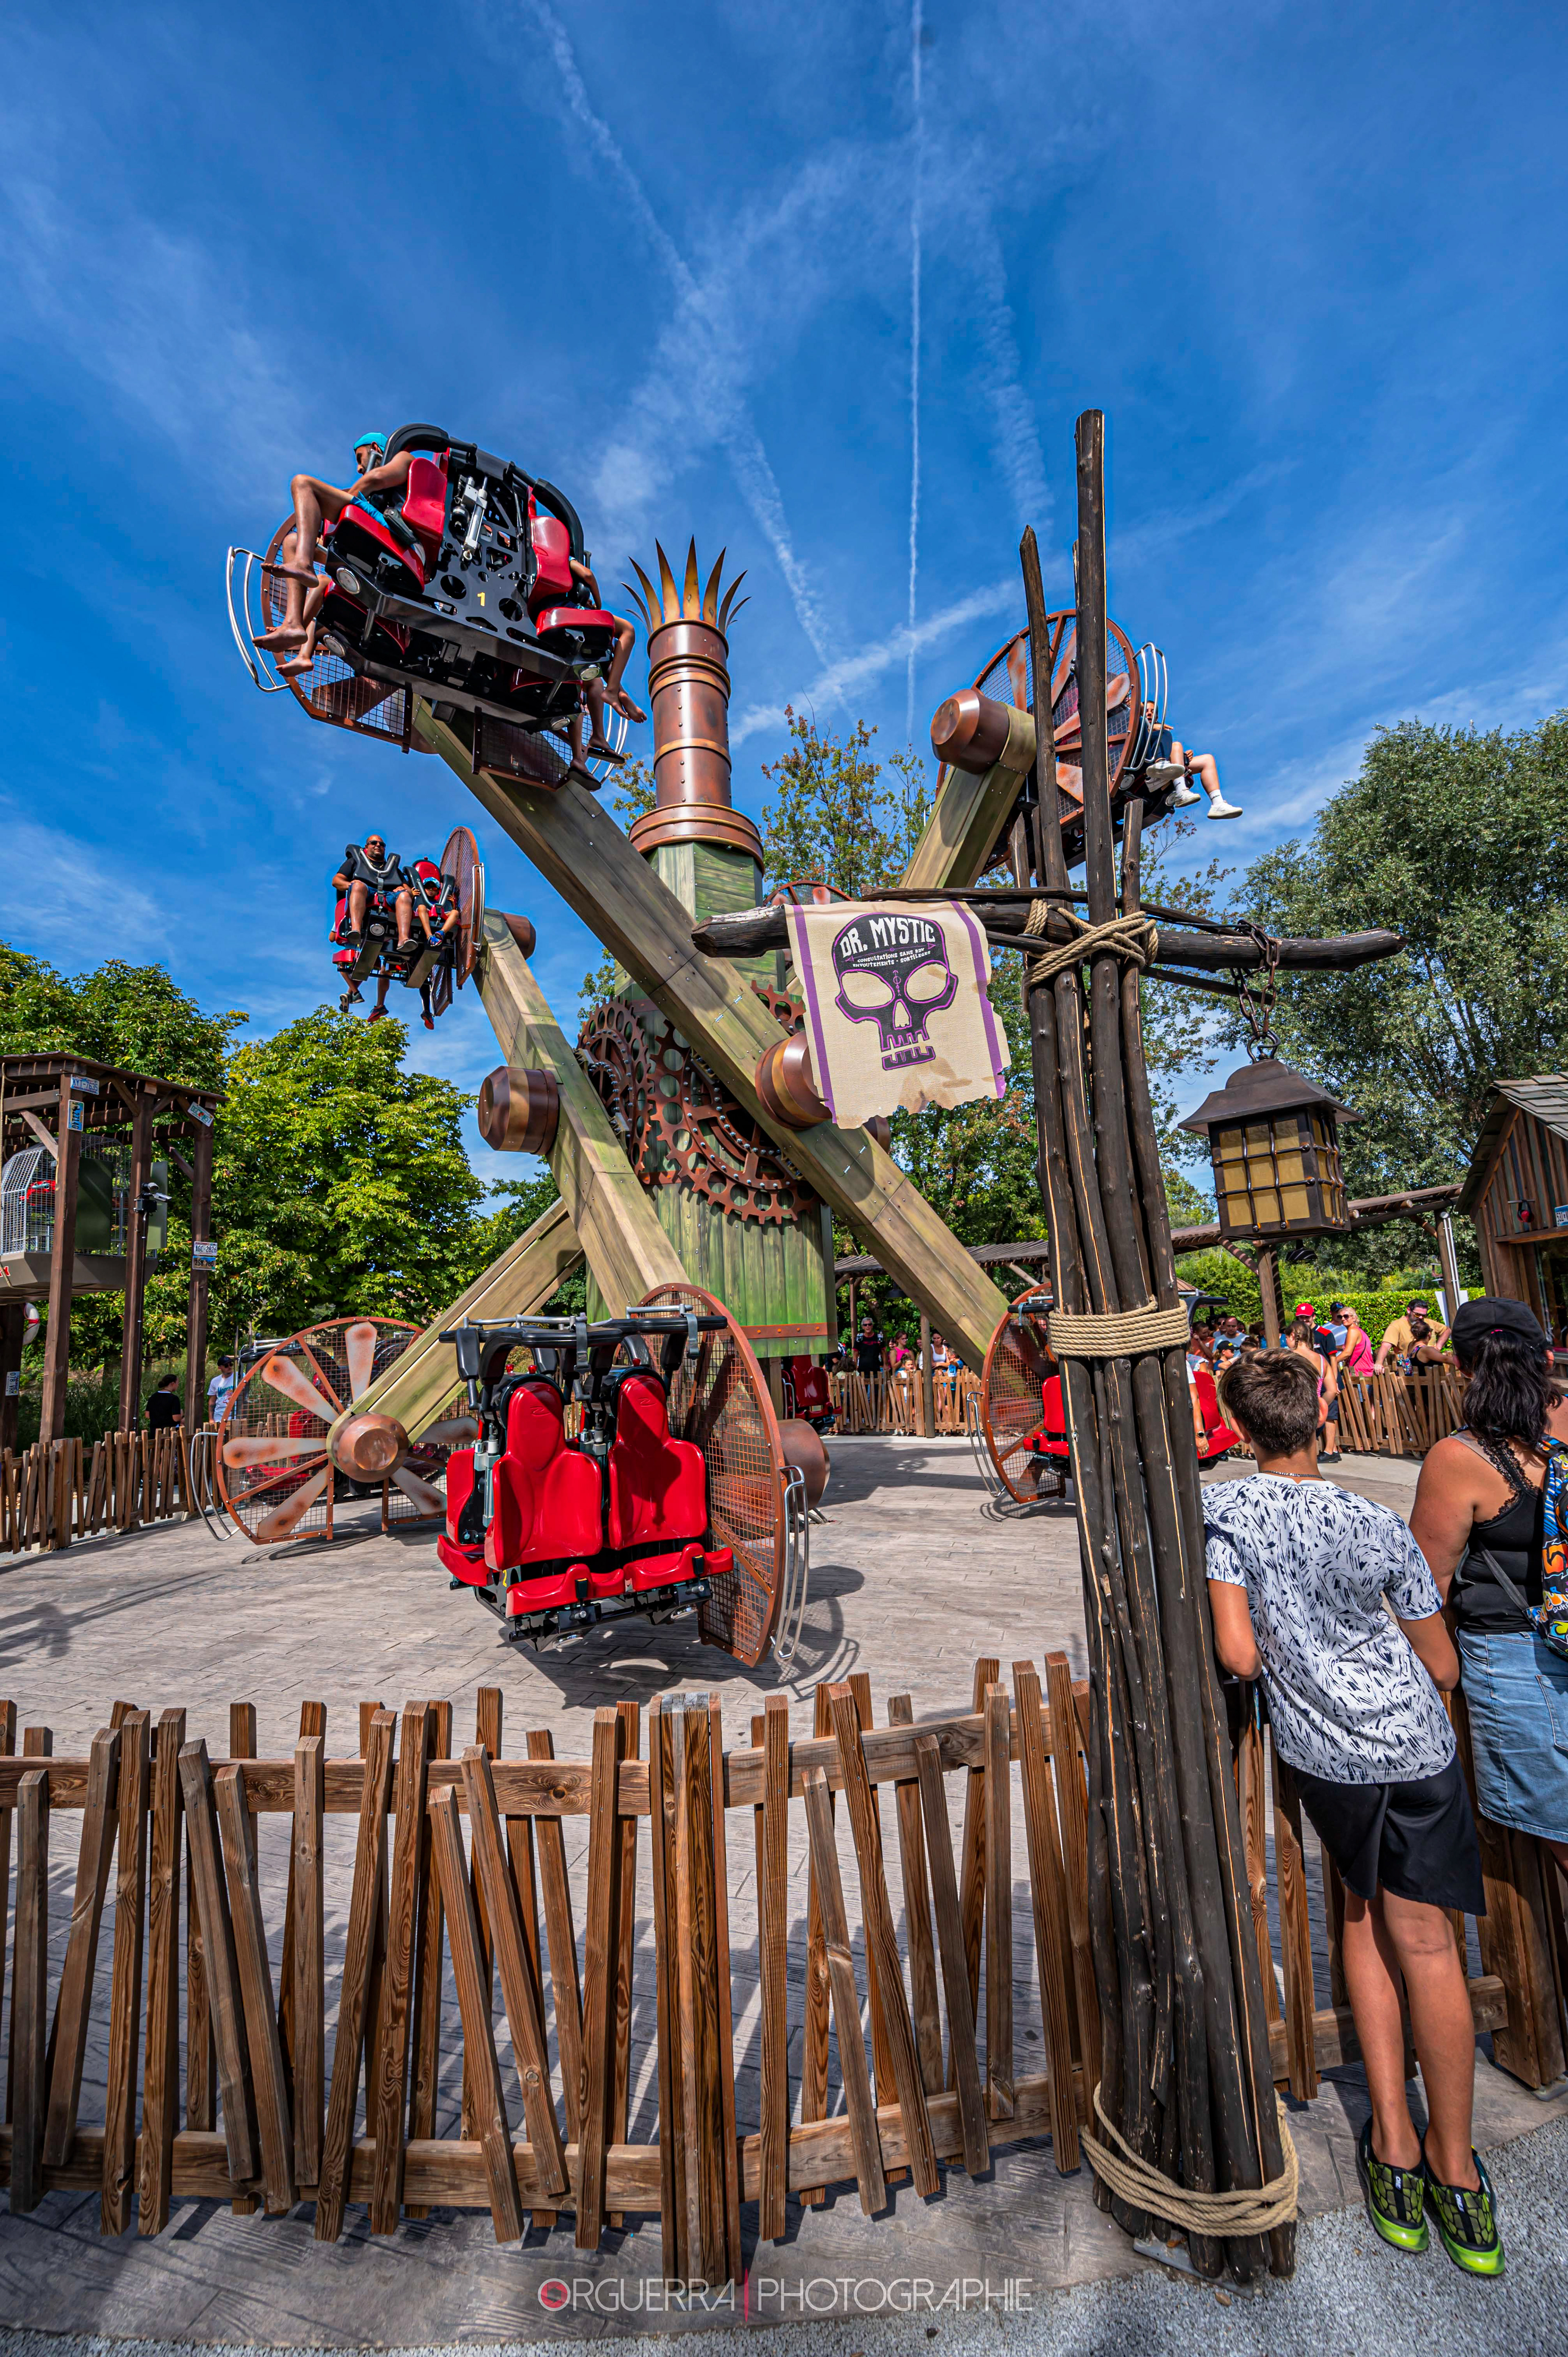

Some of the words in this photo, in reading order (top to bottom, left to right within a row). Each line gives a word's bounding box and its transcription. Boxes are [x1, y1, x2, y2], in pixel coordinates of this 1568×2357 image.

[477, 592, 485, 607] 1
[840, 928, 868, 958] DR.
[869, 917, 935, 948] MYSTIC
[857, 953, 898, 963] CONSULTATIONS
[900, 951, 931, 963] SORTILEGES
[503, 1570, 507, 1588] 2
